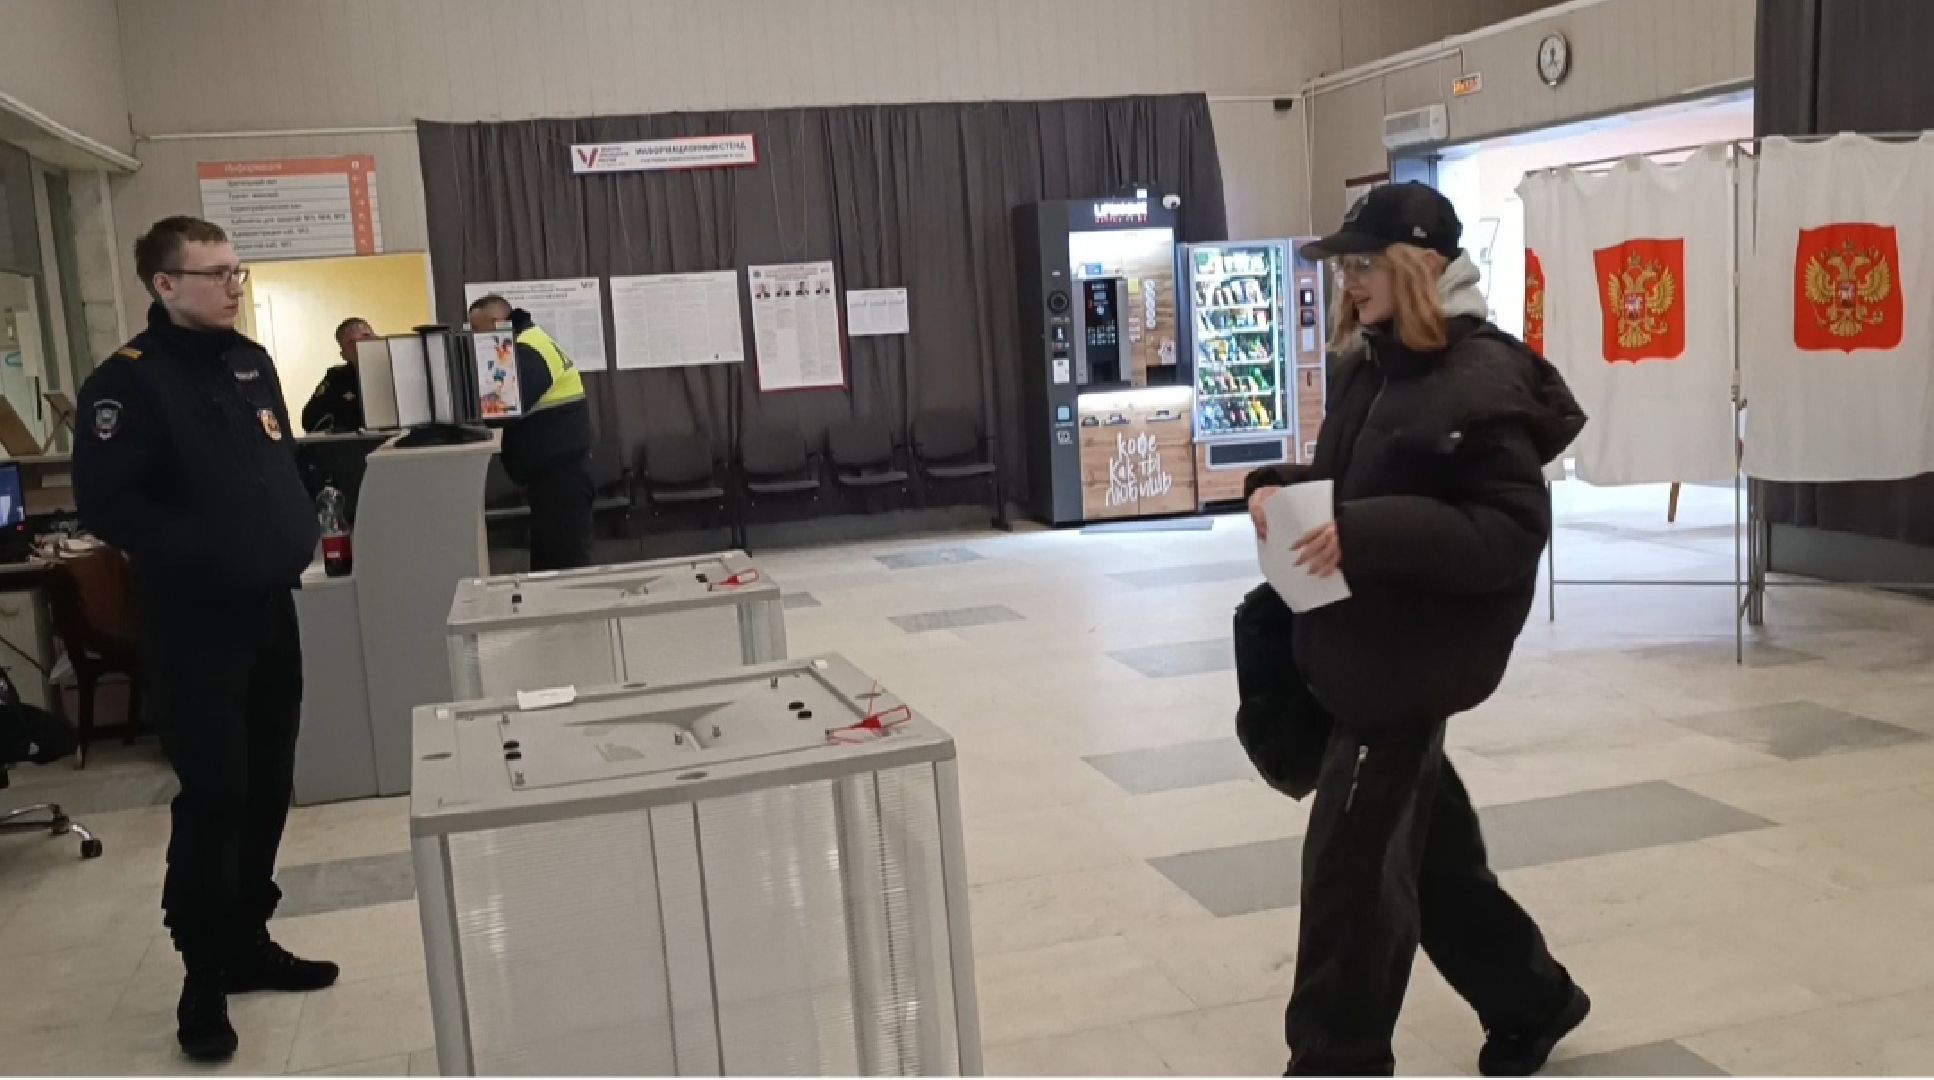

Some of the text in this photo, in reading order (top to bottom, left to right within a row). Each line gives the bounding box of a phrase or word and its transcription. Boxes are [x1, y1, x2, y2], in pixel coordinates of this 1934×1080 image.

[720, 140, 747, 152] СТЕНД
[1116, 430, 1157, 462] кофе
[1105, 471, 1172, 507] любишь
